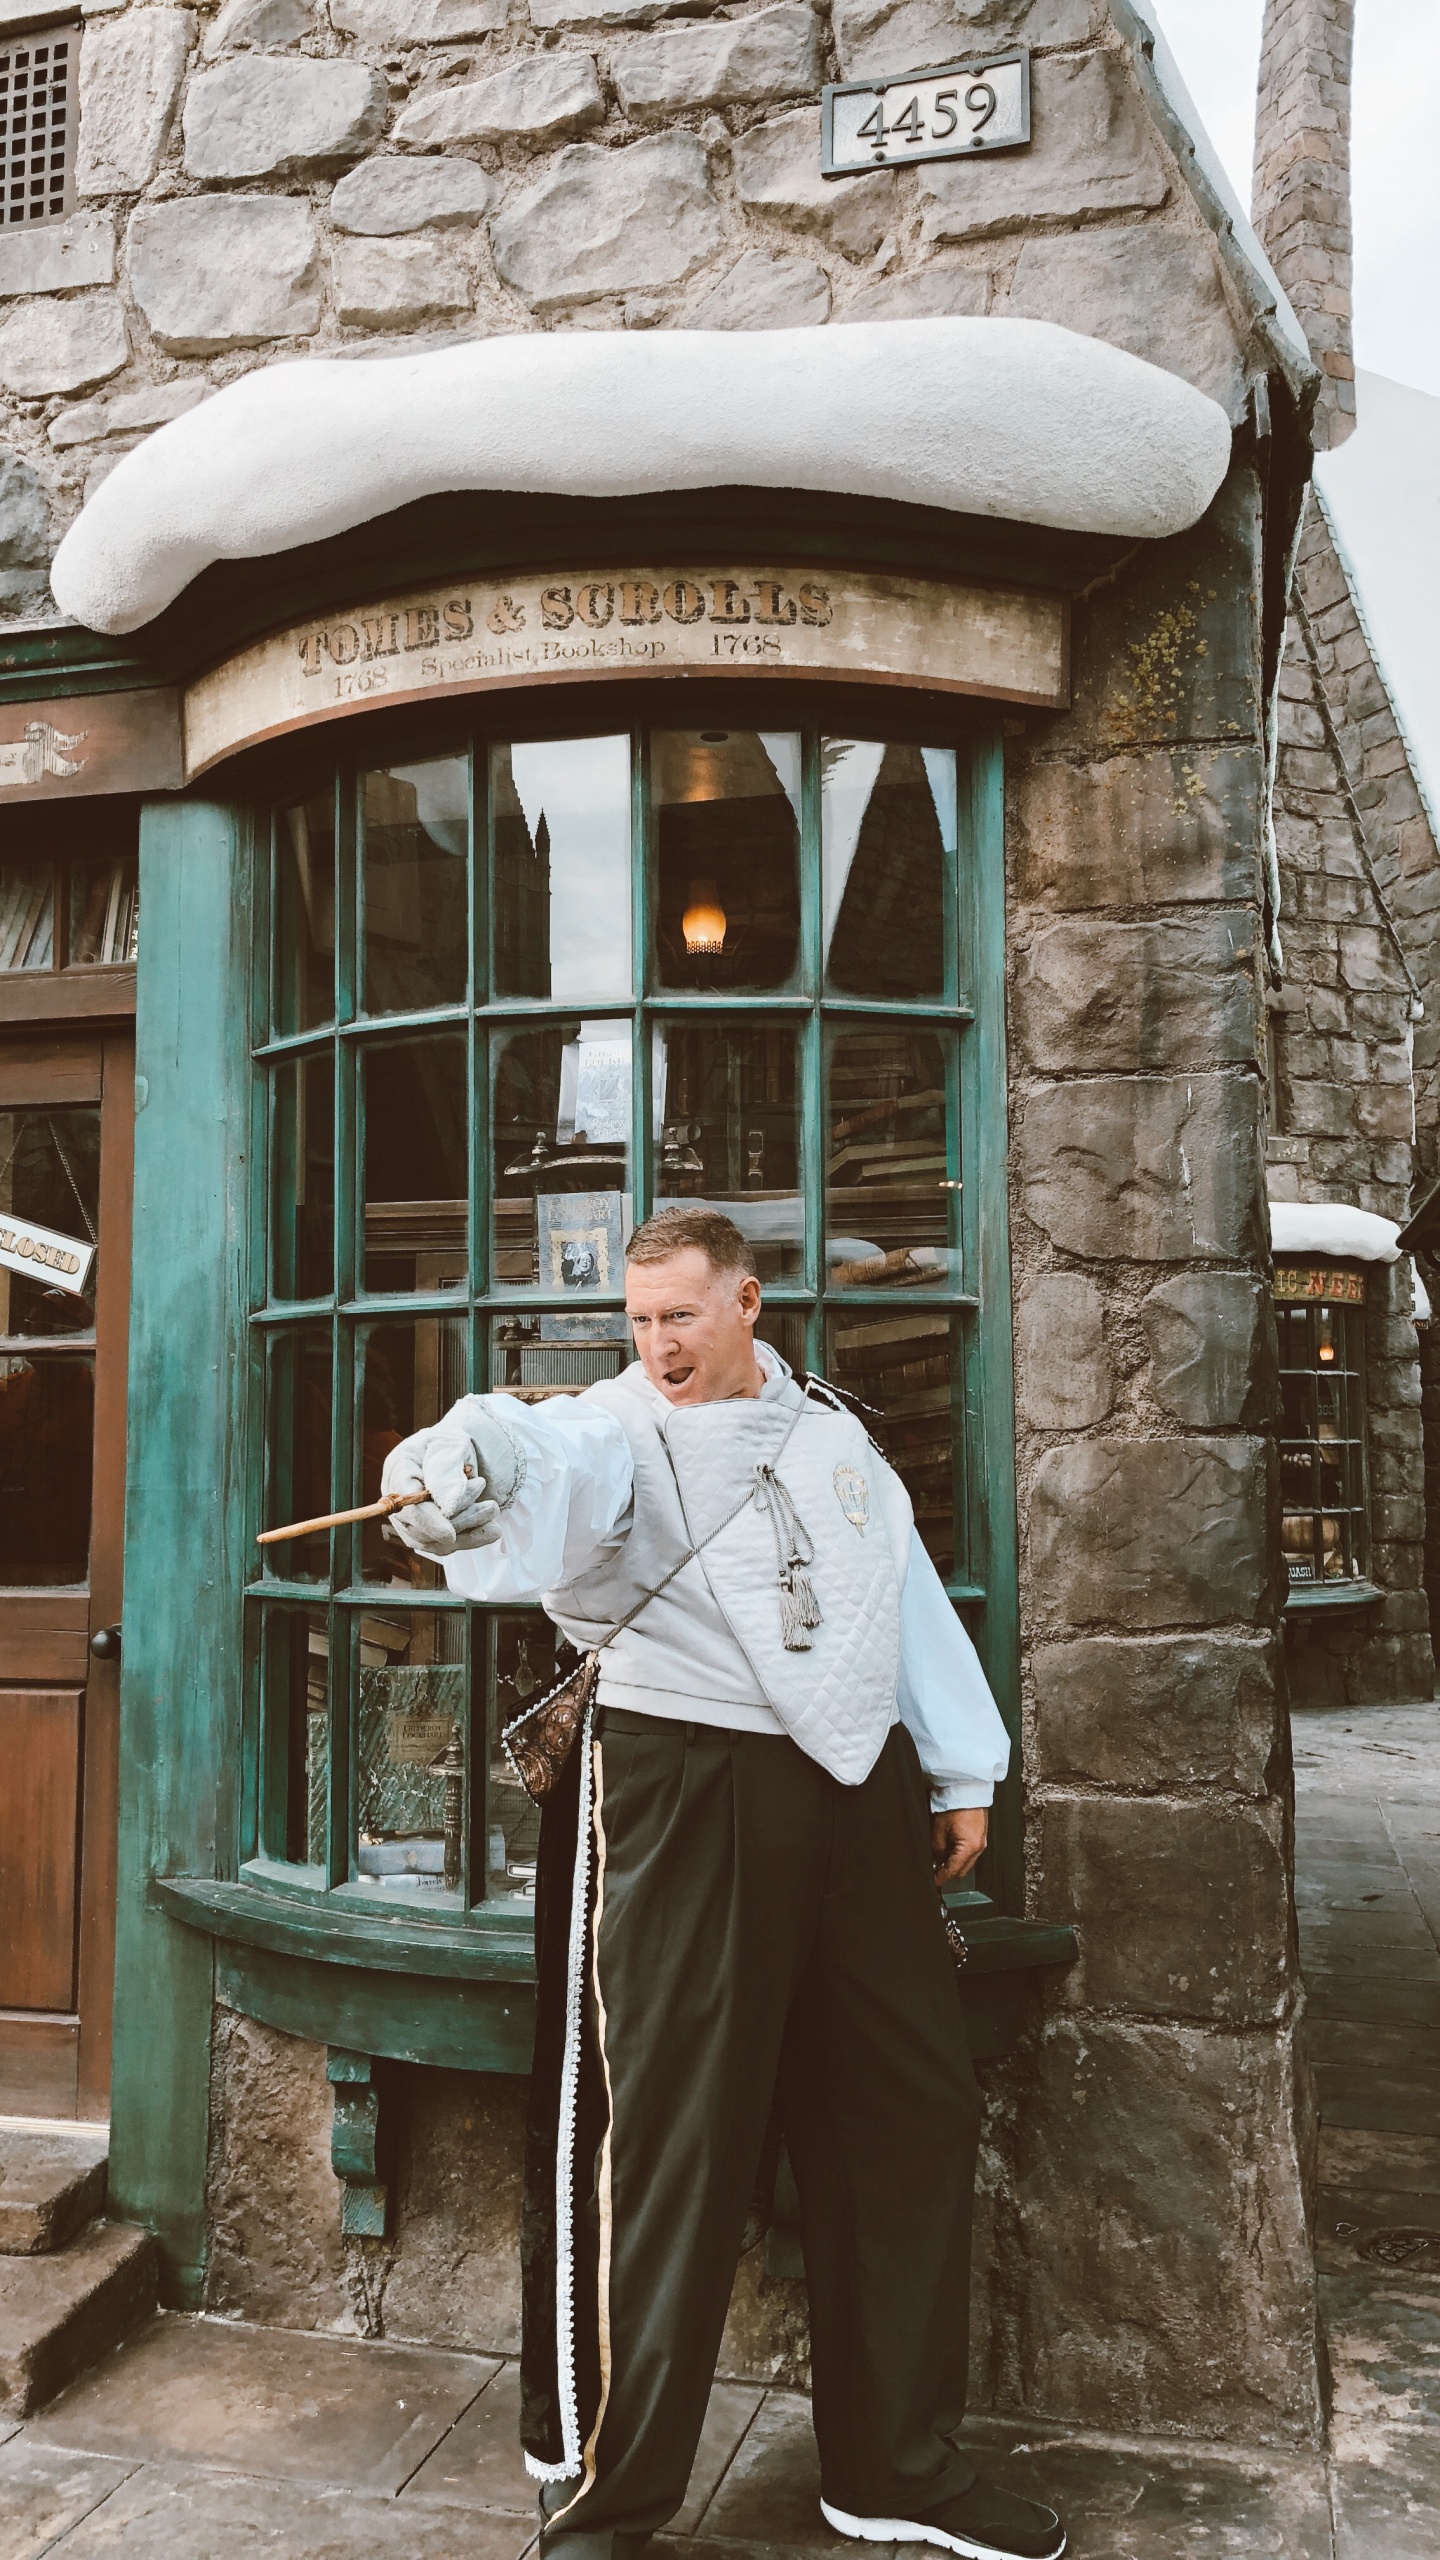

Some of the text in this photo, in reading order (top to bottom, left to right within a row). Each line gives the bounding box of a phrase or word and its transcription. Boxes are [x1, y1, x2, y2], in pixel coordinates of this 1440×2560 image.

[856, 82, 997, 148] 4459
[298, 579, 834, 677] TOMES & SCROLLS
[334, 633, 783, 699] 1768 Specialist Bookshop 1768
[1288, 1566, 1312, 1578] UASH
